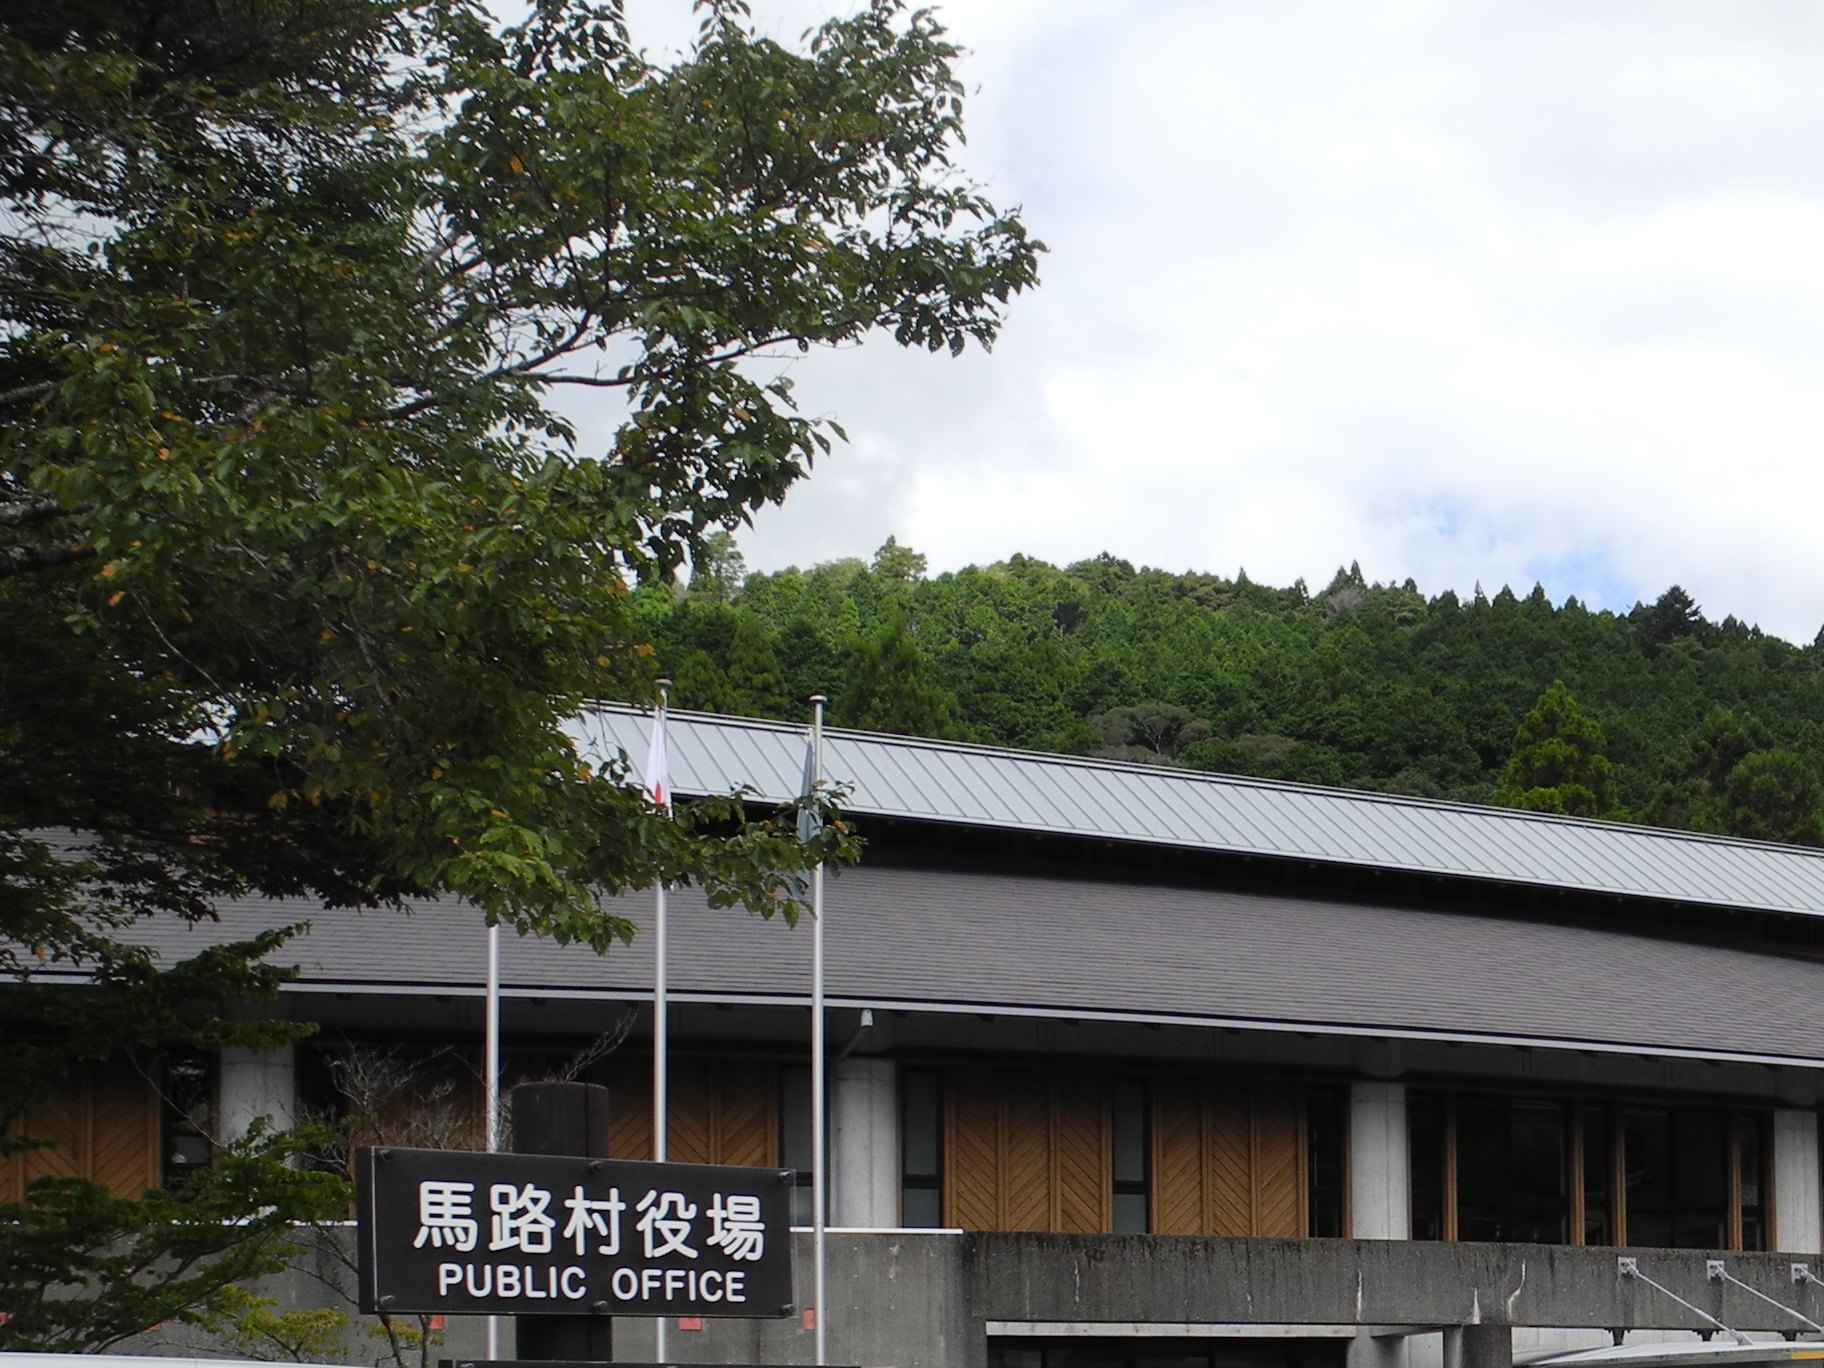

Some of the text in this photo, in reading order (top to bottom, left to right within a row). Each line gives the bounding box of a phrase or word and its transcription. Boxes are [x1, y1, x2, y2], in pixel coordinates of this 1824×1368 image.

[413, 1180, 766, 1262] 馬路村役場
[438, 1262, 747, 1303] PUBLIC OFFICE
